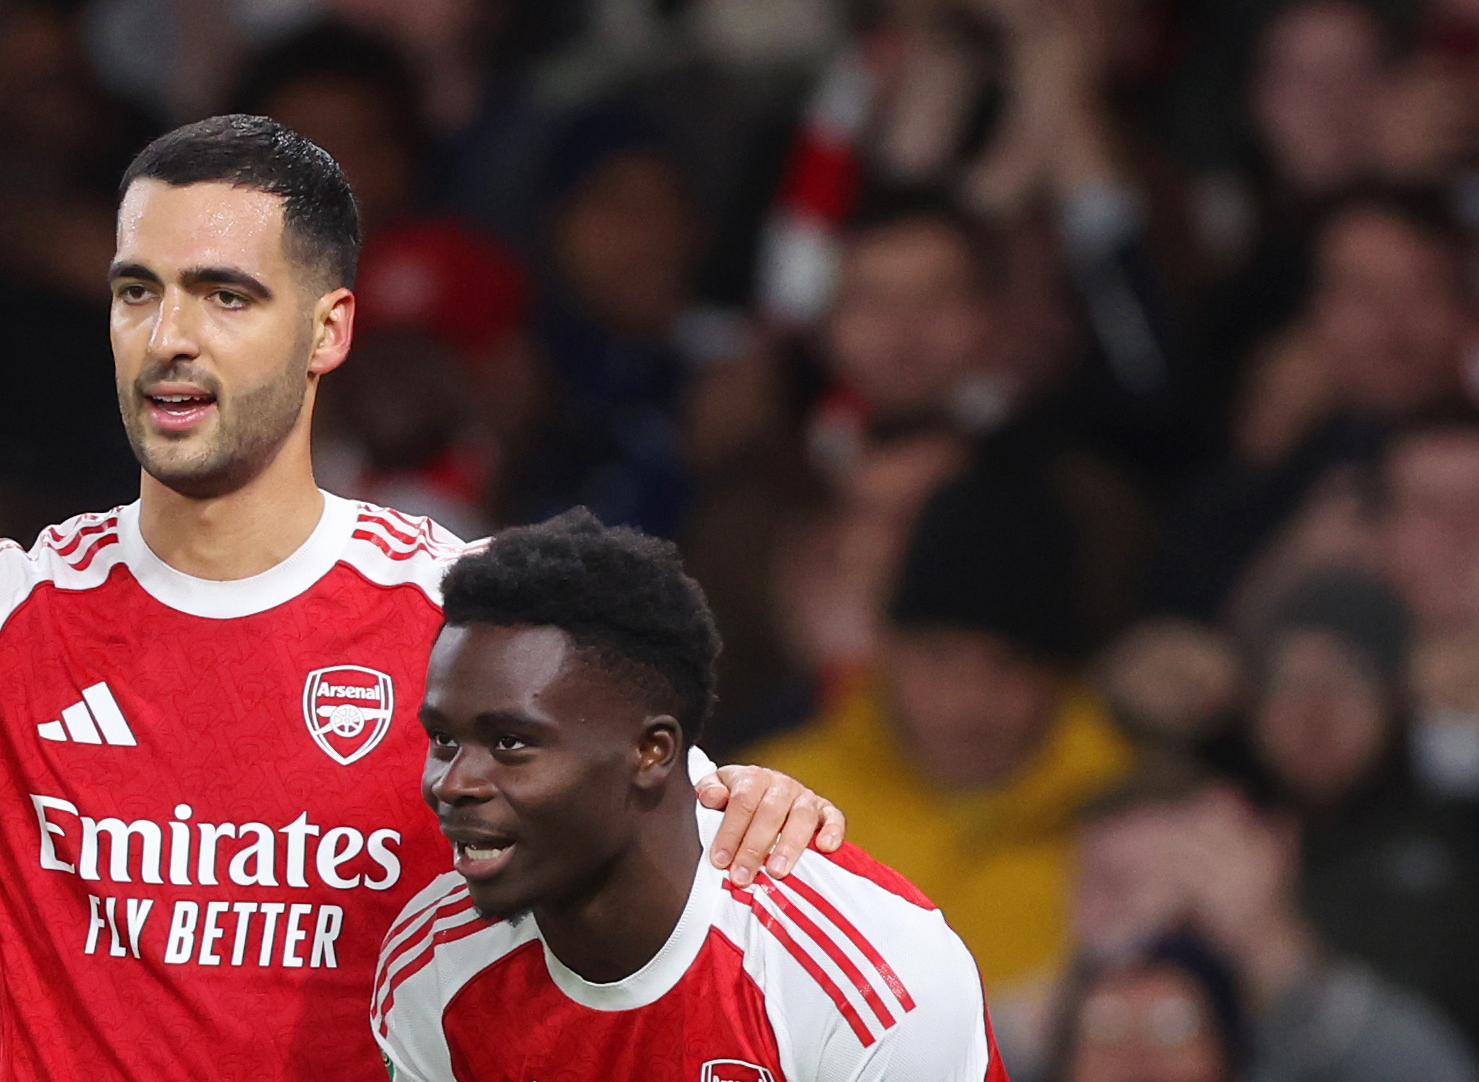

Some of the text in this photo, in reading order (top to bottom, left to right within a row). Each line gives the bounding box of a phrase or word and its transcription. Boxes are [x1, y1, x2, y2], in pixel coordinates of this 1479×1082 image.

[316, 681, 381, 700] Arsenal
[29, 793, 402, 890] Emirates
[84, 894, 344, 968] FLY BETTER
